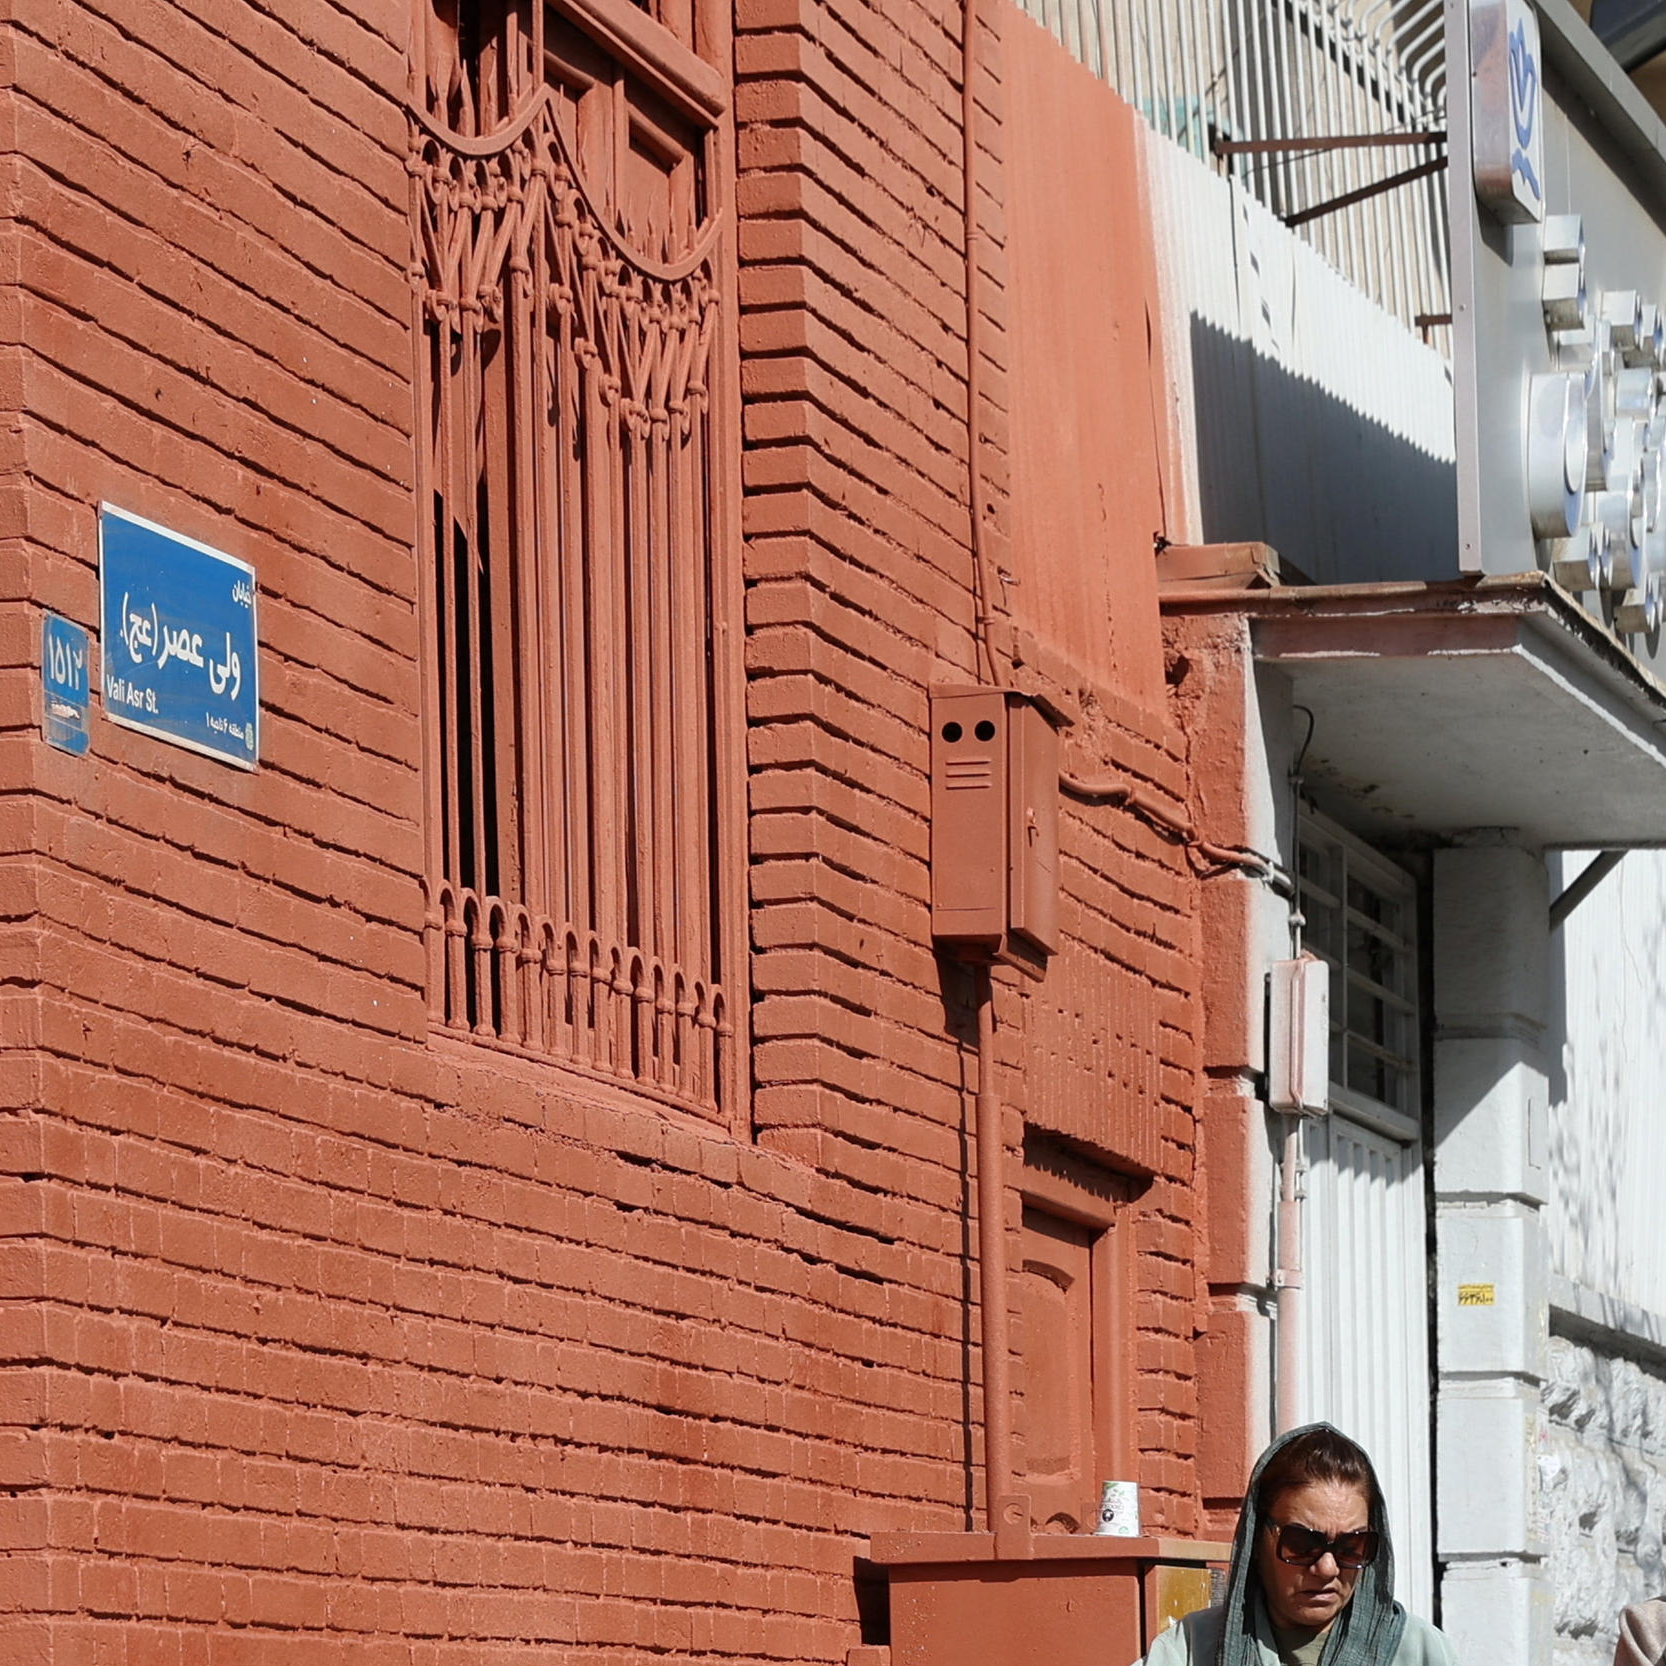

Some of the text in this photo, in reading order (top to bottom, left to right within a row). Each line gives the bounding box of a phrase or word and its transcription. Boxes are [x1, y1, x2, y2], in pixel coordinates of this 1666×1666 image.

[232, 579, 252, 609] خیابان
[157, 626, 204, 669] عصر
[210, 632, 241, 701] ولی
[106, 674, 160, 715] Vali Asr St.
